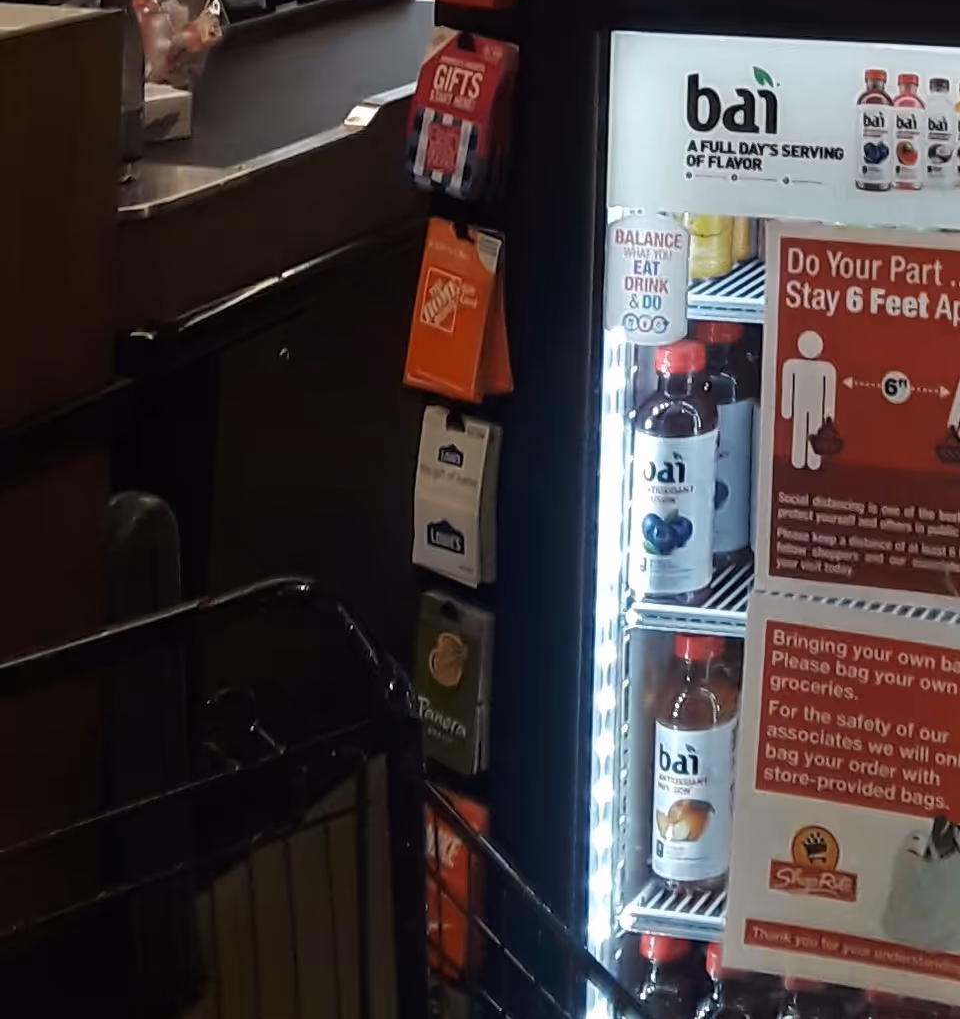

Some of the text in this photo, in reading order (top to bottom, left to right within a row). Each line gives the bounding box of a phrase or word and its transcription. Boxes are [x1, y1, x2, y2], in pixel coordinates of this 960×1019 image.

[433, 64, 483, 99] GIFTS
[687, 68, 778, 134] bai
[686, 154, 763, 171] OF FLAVOR
[687, 140, 845, 161] A FULL DAY'S SERVING
[615, 229, 682, 249] BALANCE
[623, 247, 650, 259] WHAT
[634, 260, 660, 276] EAT
[787, 247, 820, 275] Do
[827, 249, 882, 280] Your
[890, 255, 942, 286] Part
[624, 276, 669, 294] DRINK
[629, 294, 662, 310] & DO
[785, 280, 840, 317] Stay
[845, 285, 864, 313] 6
[870, 287, 930, 319] Feet
[773, 629, 847, 658] Bringing
[853, 645, 892, 661] your
[898, 651, 936, 670] own
[770, 674, 860, 702] groceries.
[771, 649, 958, 695] Please bag your own
[768, 700, 949, 744] For the safety of our
[659, 742, 699, 775] bai
[766, 723, 862, 753] associates
[868, 741, 894, 756] we
[899, 743, 930, 763] will
[765, 743, 941, 787] bag your order with
[764, 765, 950, 811] store-provided bags.
[752, 926, 791, 946] Thank
[794, 936, 818, 950] you
[820, 937, 840, 951] for
